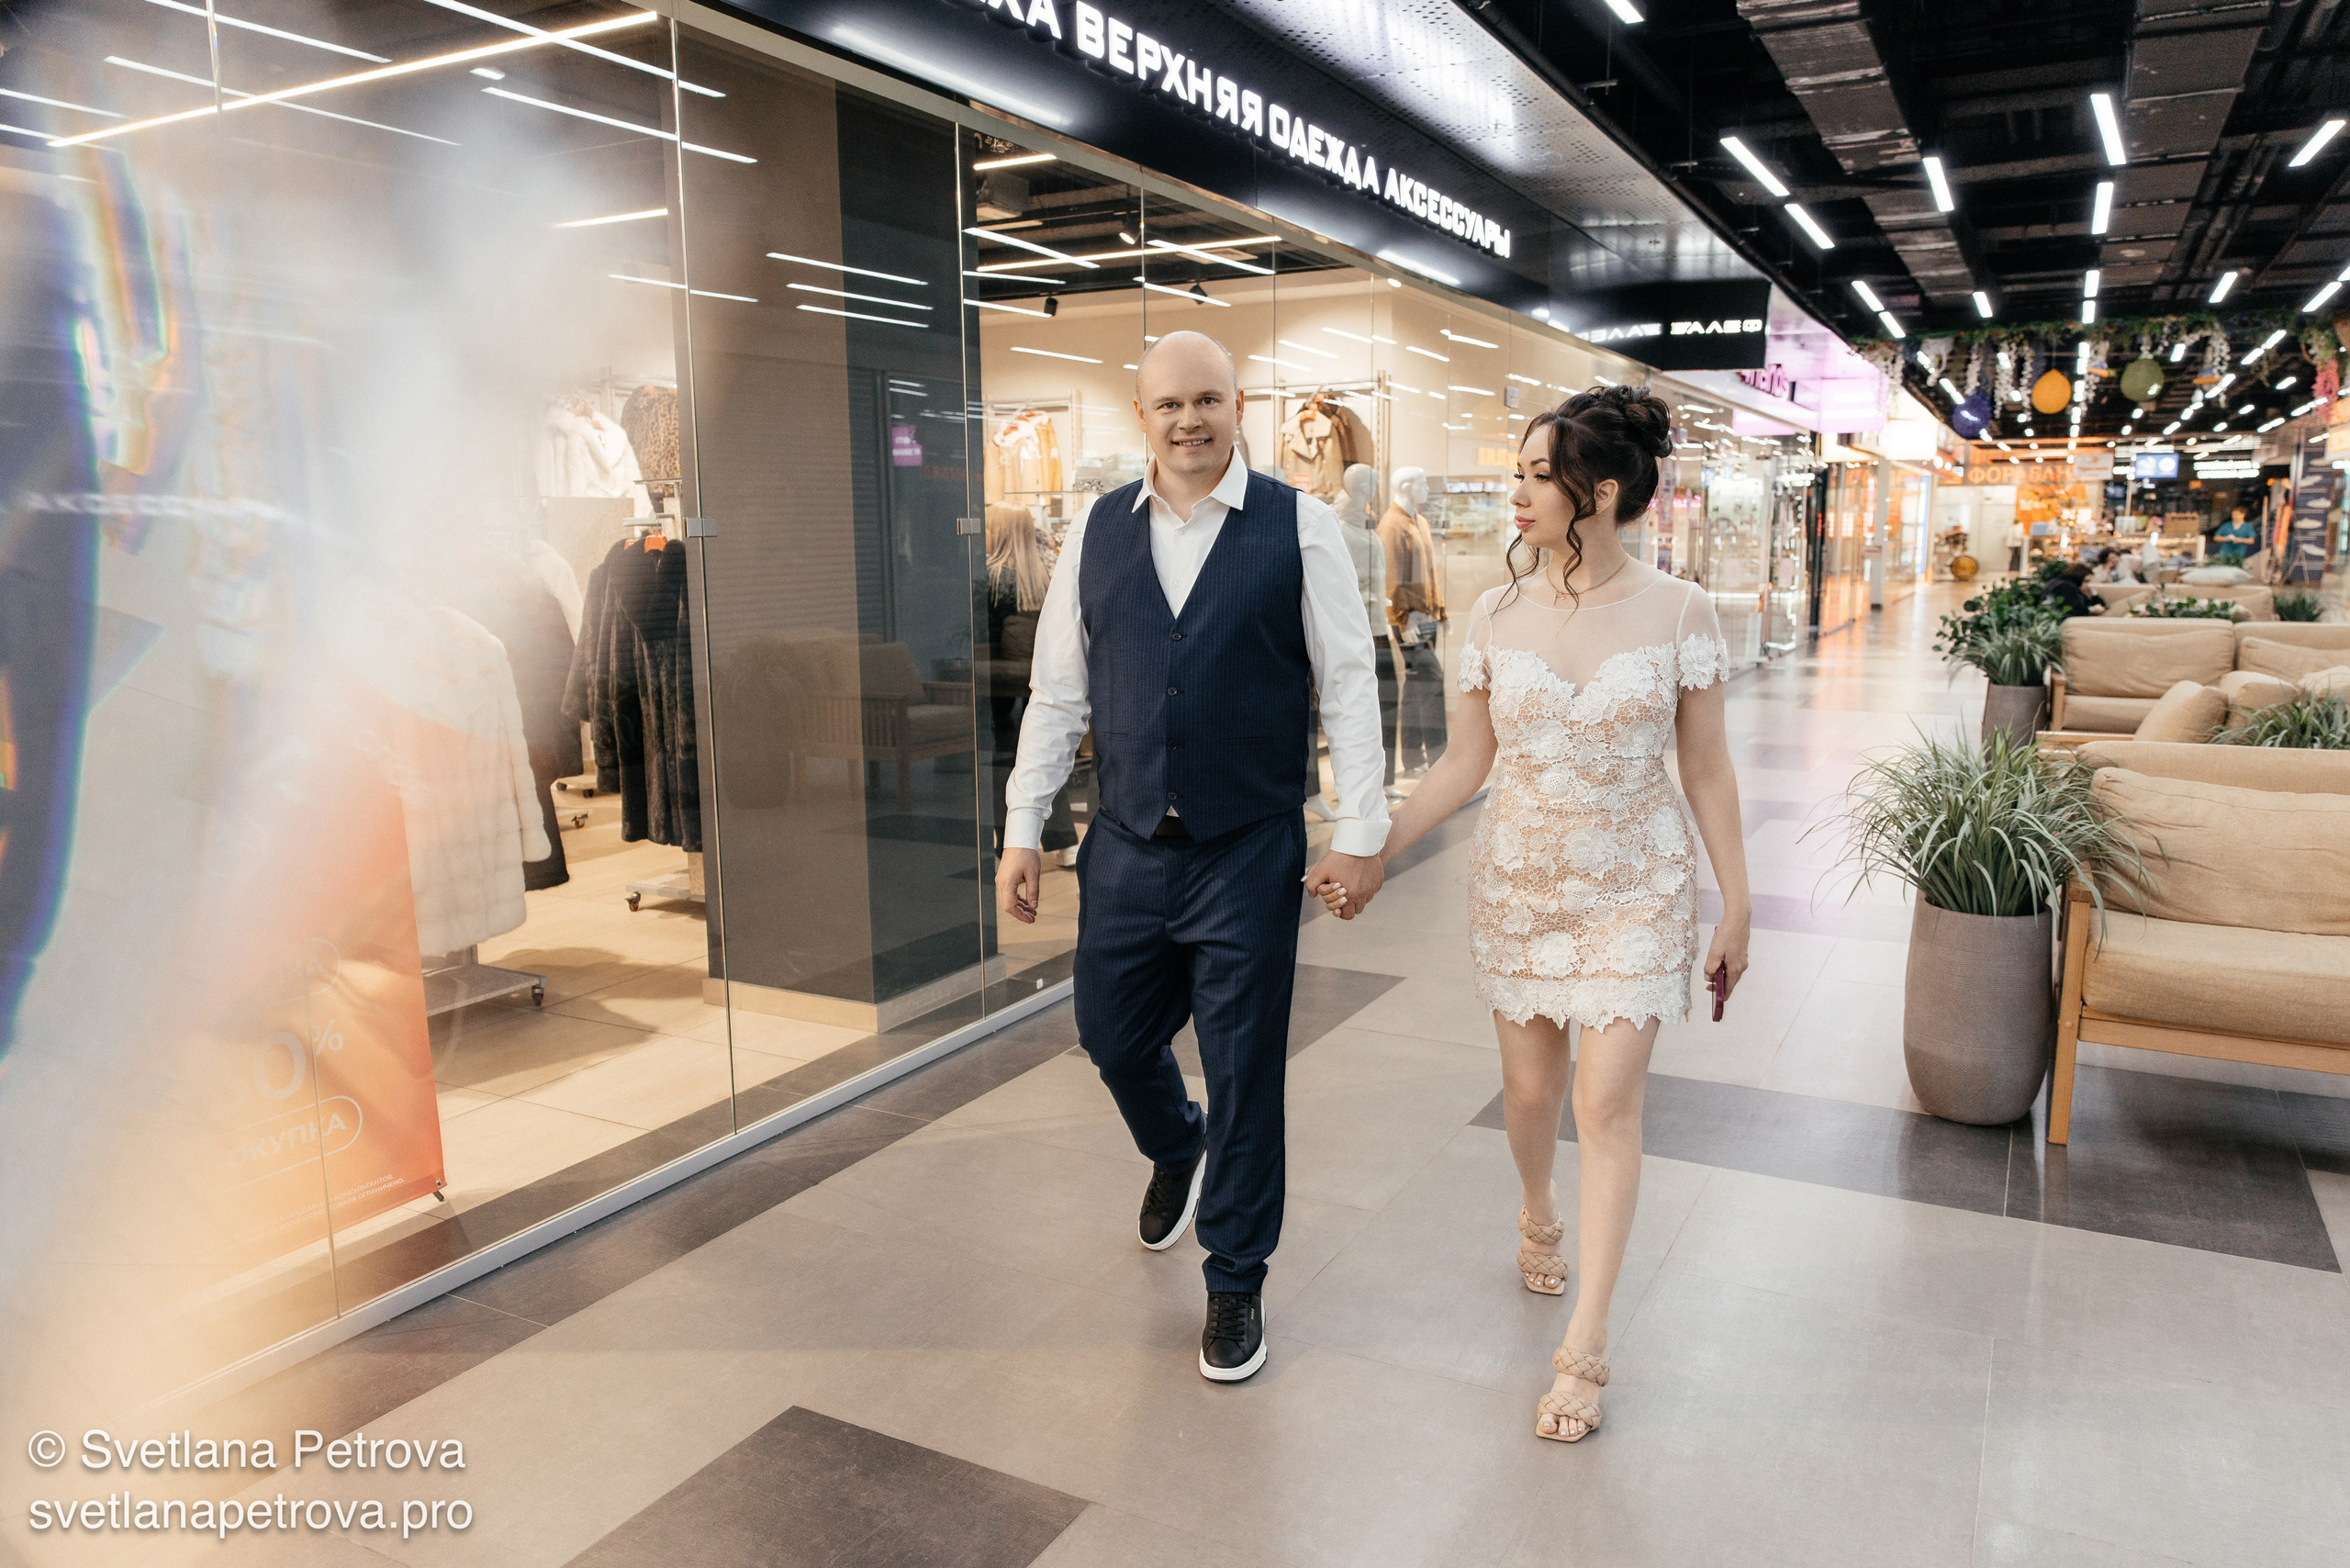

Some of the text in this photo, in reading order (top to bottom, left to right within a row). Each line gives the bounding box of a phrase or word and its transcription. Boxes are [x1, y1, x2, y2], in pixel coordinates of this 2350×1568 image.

[1076, 0, 1263, 137] ВЕРХНЯЯ
[1269, 103, 1381, 195] ОДЕЖДА
[1383, 167, 1511, 258] АКСЕССУАРЫ
